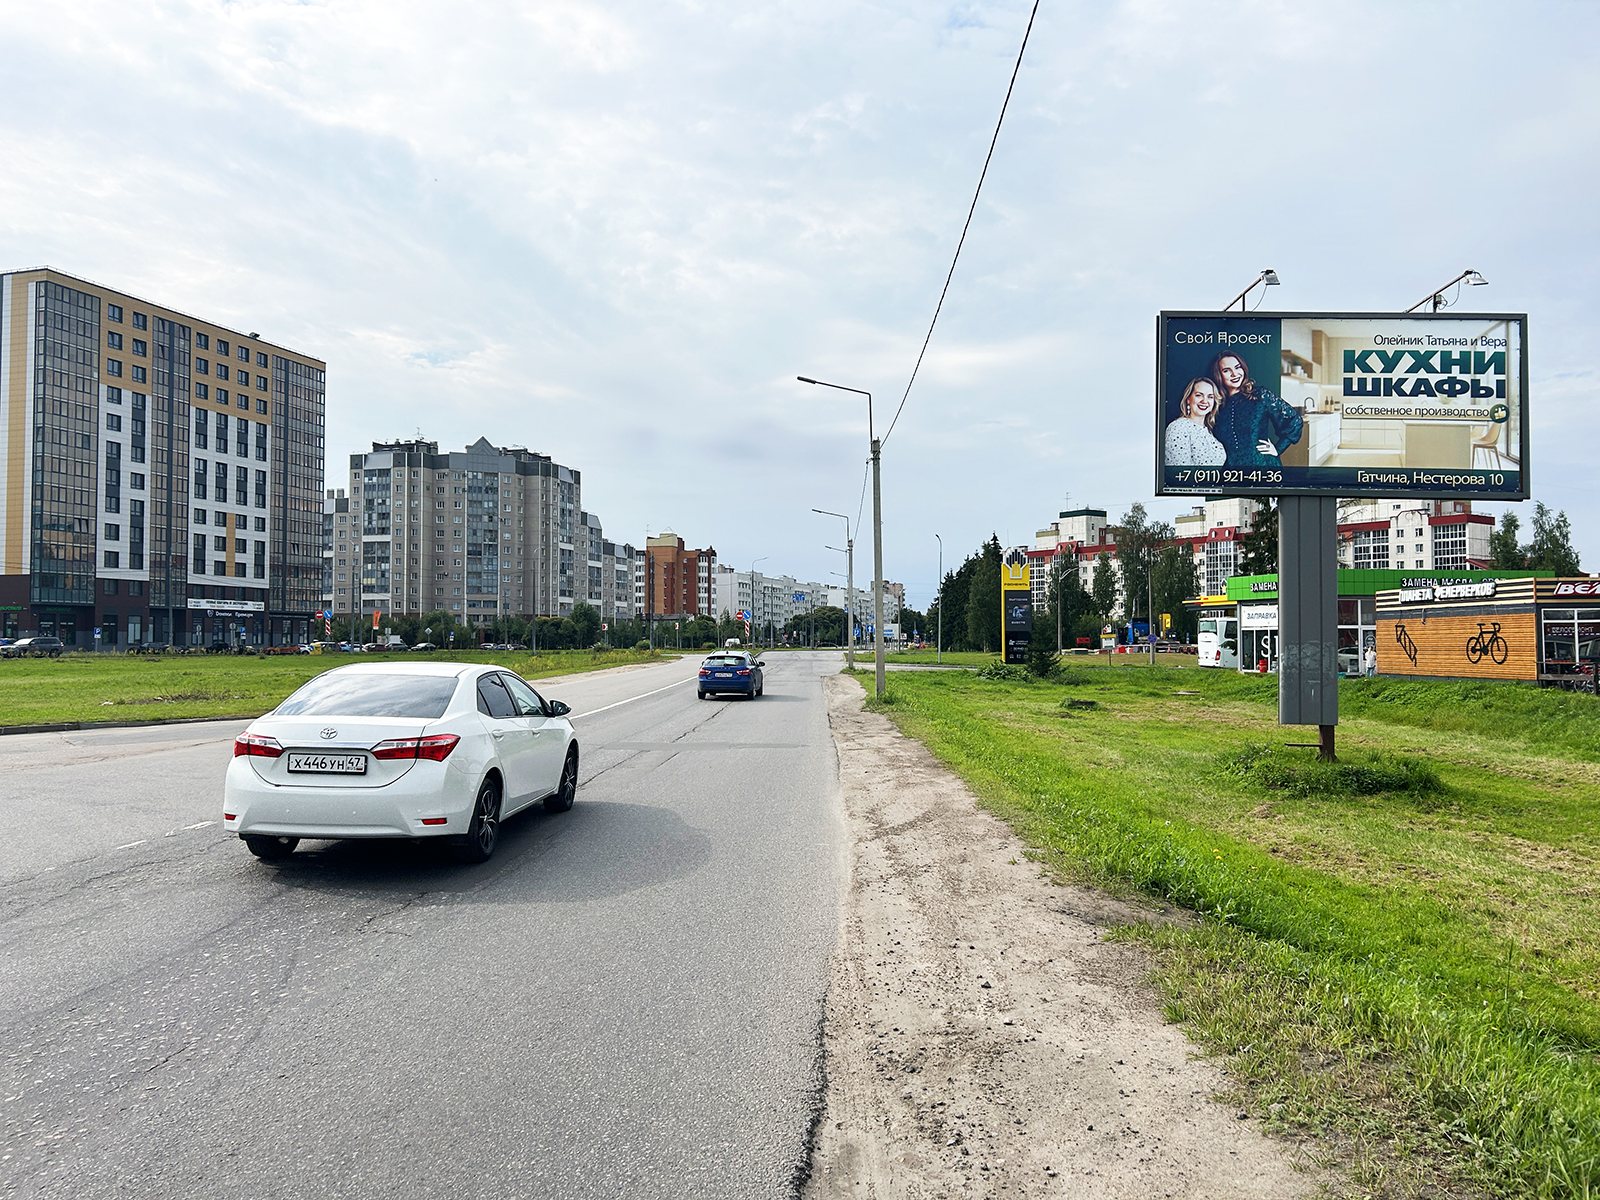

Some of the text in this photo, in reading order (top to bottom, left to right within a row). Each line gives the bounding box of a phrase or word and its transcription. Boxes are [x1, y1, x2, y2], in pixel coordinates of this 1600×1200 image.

[1174, 331, 1272, 347] Свой Проект
[1373, 334, 1507, 349] Олейник Татьяна и Вера
[1343, 350, 1506, 375] КУХНИ
[1343, 376, 1506, 399] ШКАФЫ
[1344, 405, 1490, 418] собственное производство
[1175, 470, 1283, 483] +7 (911) 921-41-36
[1357, 470, 1504, 487] Гатчина, Нестерова 10
[1249, 581, 1278, 592] ЗАМЕНА
[1401, 578, 1438, 588] ЗАМЕНА
[348, 757, 361, 767] 47
